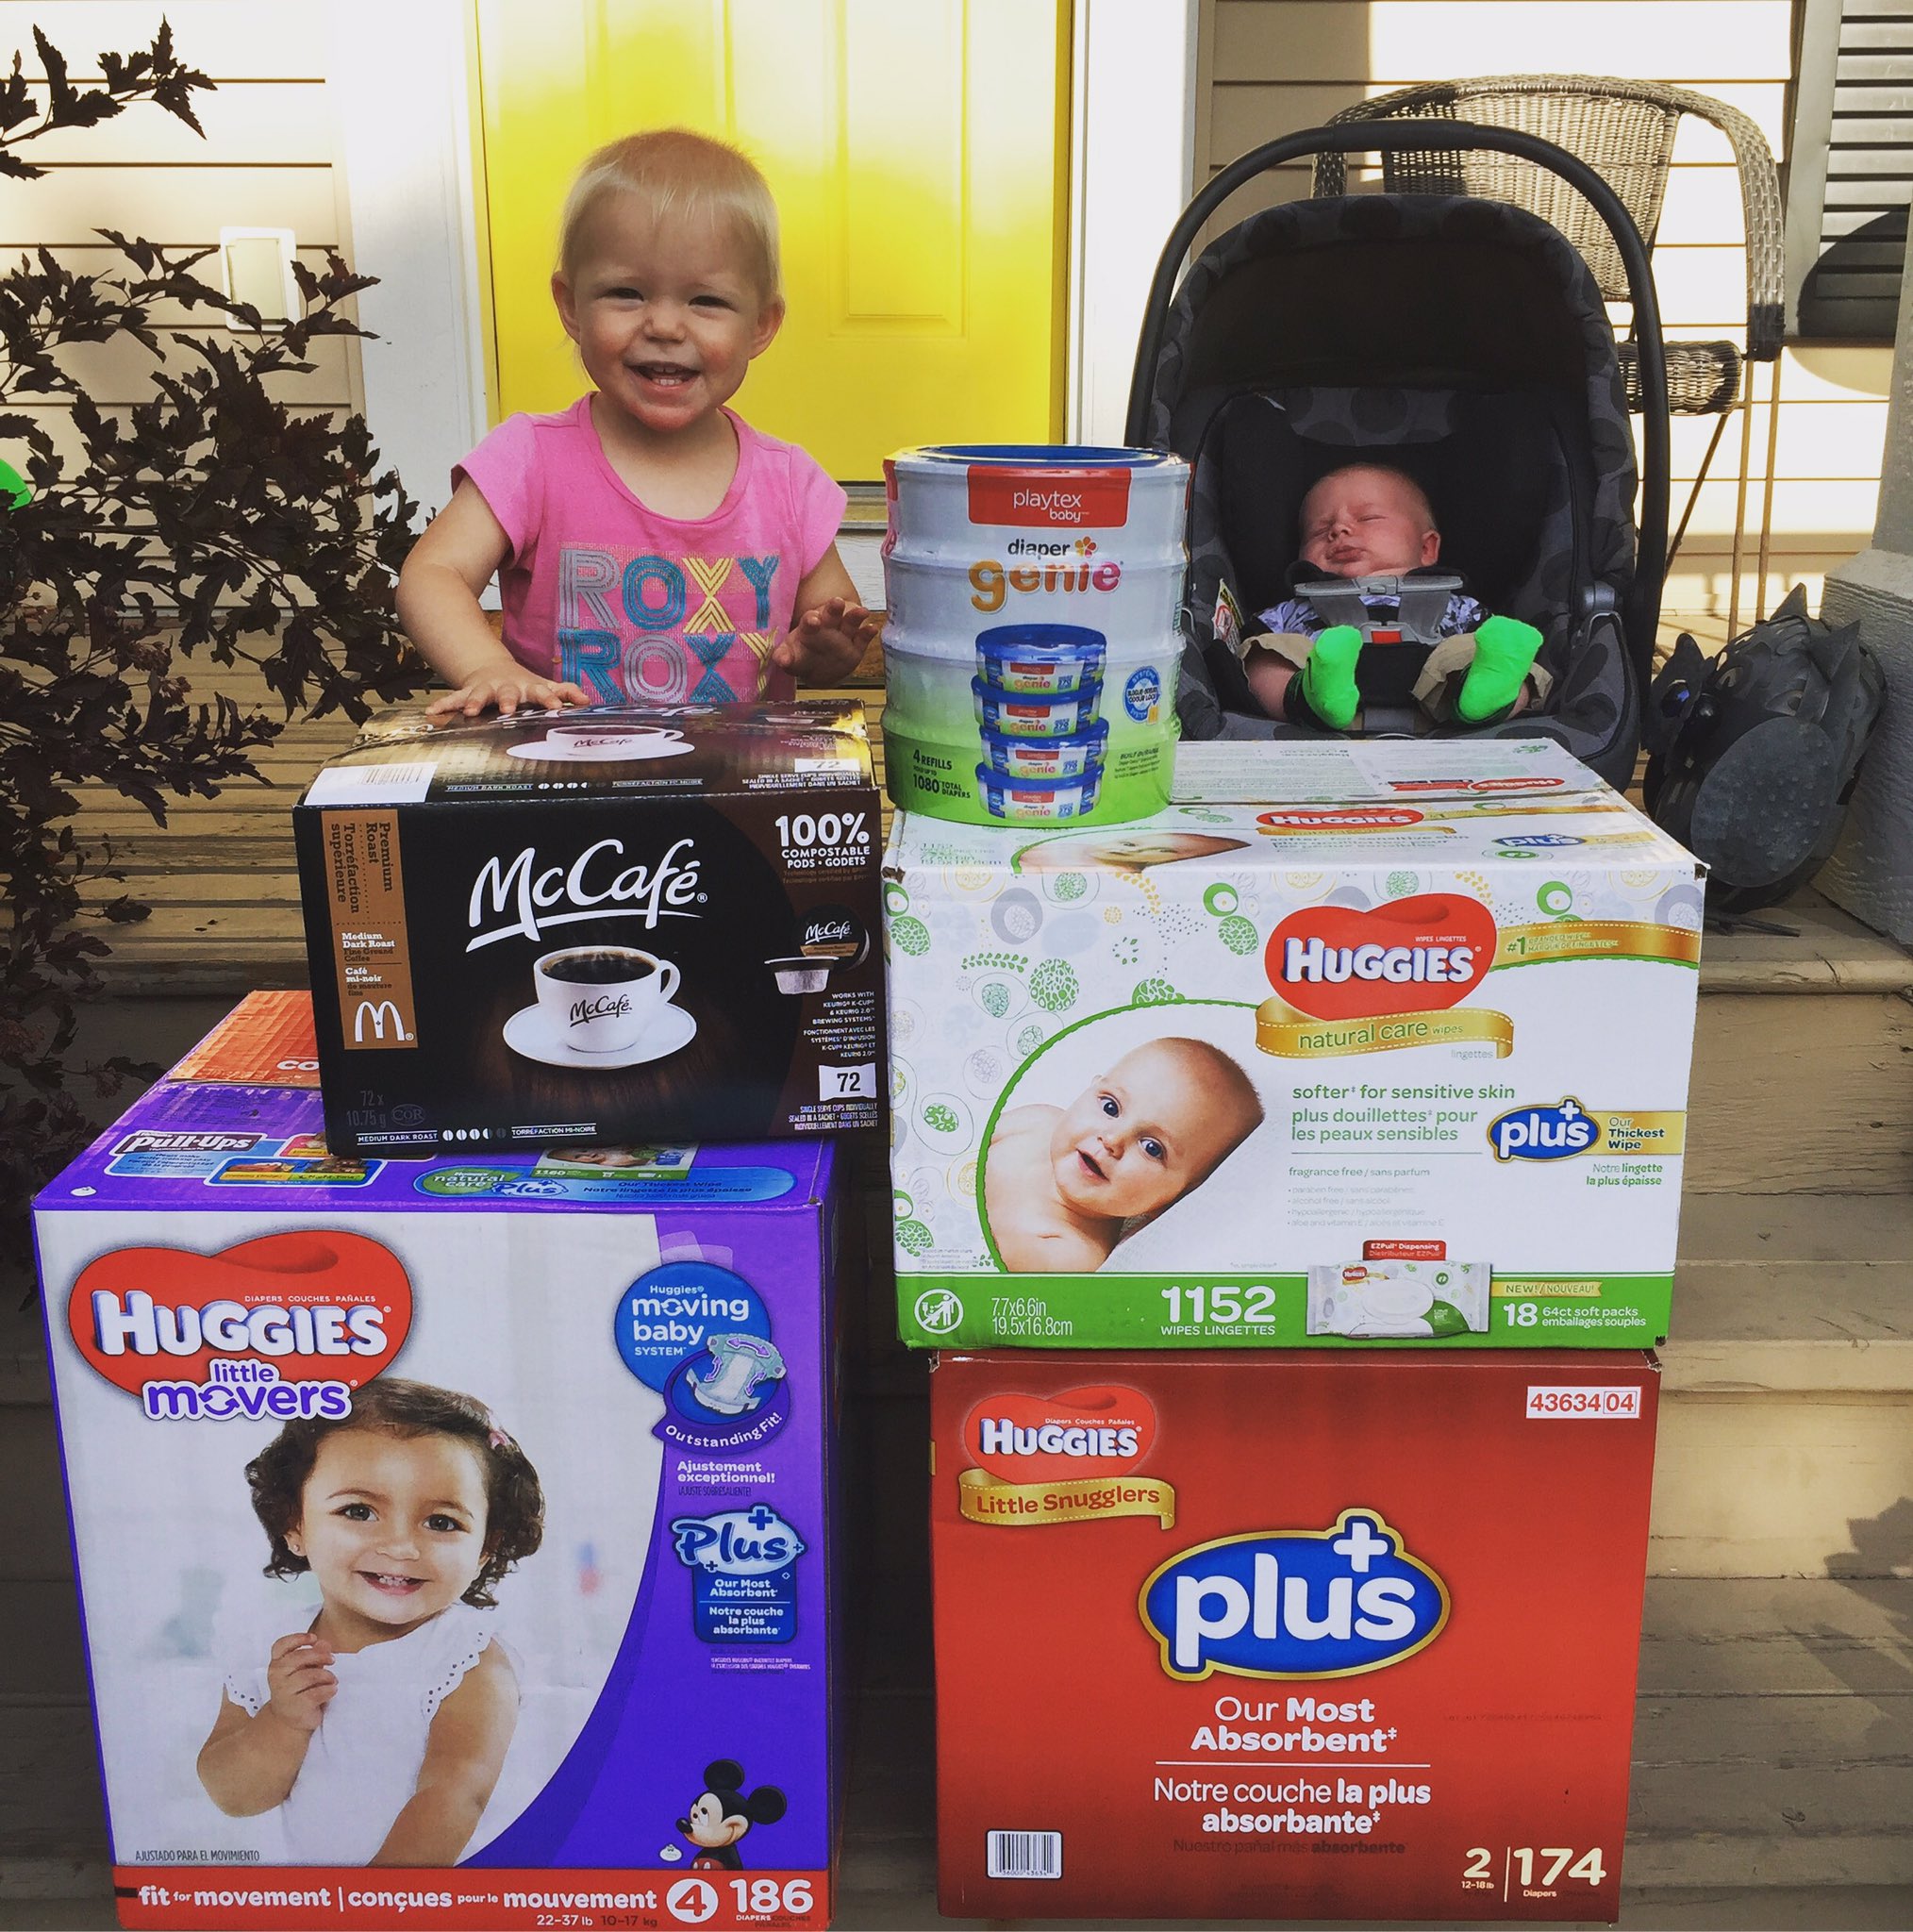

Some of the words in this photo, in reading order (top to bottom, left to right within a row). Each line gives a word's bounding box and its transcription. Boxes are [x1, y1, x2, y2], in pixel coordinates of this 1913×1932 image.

[1013, 489, 1082, 510] playtex
[1049, 508, 1081, 524] baby
[1007, 538, 1071, 560] diaper
[558, 548, 780, 634] ROXY
[968, 558, 1122, 614] genie
[913, 749, 920, 763] 4
[921, 755, 952, 770] REFILLS
[913, 774, 940, 793] 1080
[941, 781, 961, 791] TOTAL
[941, 789, 971, 798] DIAPERS
[775, 812, 870, 847] 100%
[366, 823, 378, 864] Roast
[781, 846, 871, 858] COMPOSTABLE
[329, 824, 347, 903] supérieure
[379, 823, 393, 891] Premium
[787, 858, 815, 869] PODS
[825, 857, 866, 867] GODETS
[343, 823, 360, 913] Torréfaction
[467, 839, 704, 946] McCafé
[341, 932, 383, 941] Medium
[805, 921, 851, 943] McCafé
[342, 940, 368, 948] Dark
[368, 940, 396, 948] Roast
[1506, 936, 1526, 955] #1
[1283, 937, 1474, 985] HUGGIES
[344, 967, 368, 975] Café
[345, 974, 383, 983] mi-noir
[570, 994, 632, 1026] McCafé
[803, 1027, 848, 1036] FONCTIONNENT
[1299, 1024, 1375, 1051] natural
[1379, 1020, 1428, 1041] care
[1432, 1024, 1464, 1037] wipes
[1451, 1049, 1493, 1061] lingettes
[837, 1072, 861, 1092] 72
[360, 1091, 374, 1107] 72
[377, 1094, 385, 1106] x
[1292, 1084, 1350, 1099] softer
[1359, 1084, 1388, 1099] for
[1391, 1084, 1473, 1099] sensitive
[1478, 1084, 1516, 1099] skin
[346, 1110, 377, 1127] 10.75
[859, 1119, 878, 1127] SACHET
[1291, 1108, 1329, 1125] plus
[1333, 1108, 1427, 1123] douillettes
[1436, 1110, 1478, 1125] pour
[1609, 1117, 1633, 1127] Our
[358, 1135, 388, 1143] MEDIUM
[1291, 1126, 1316, 1141] les
[1320, 1130, 1373, 1144] peaux
[1376, 1126, 1459, 1141] sensibles
[1499, 1112, 1589, 1158] plus
[1609, 1128, 1665, 1138] Thickest
[128, 1134, 251, 1152] Pull-Ups
[1608, 1140, 1641, 1152] Wipe
[1289, 1167, 1339, 1178] fragrance
[1341, 1167, 1364, 1176] free
[1394, 1167, 1431, 1178] parfum
[1592, 1163, 1621, 1174] Notre
[1622, 1162, 1663, 1175] lingette
[1586, 1175, 1596, 1185] la
[1597, 1175, 1621, 1188] plus
[1622, 1175, 1662, 1188] épaisse
[1398, 1242, 1440, 1252] Dispensing
[335, 1293, 376, 1303] PAÑALES
[649, 1285, 698, 1295] Huggies
[632, 1293, 750, 1322] moving
[991, 1297, 1047, 1318] 7.7x6.6in
[1161, 1285, 1276, 1324] 1152
[1542, 1307, 1572, 1317] 64ct
[1574, 1306, 1599, 1317] soft
[1602, 1306, 1639, 1319] packs
[91, 1290, 389, 1357] HUGGIES
[1503, 1303, 1539, 1327] 18
[1542, 1317, 1604, 1329] emballages
[1605, 1317, 1646, 1328] souples
[633, 1320, 705, 1346] baby
[992, 1317, 1073, 1337] 19.5x16.8cm
[1161, 1325, 1201, 1336] WIPES
[1205, 1324, 1276, 1336] LINGETTES
[634, 1346, 684, 1357] SYSTEM
[210, 1360, 276, 1385] little
[146, 1383, 347, 1417] movers
[1530, 1392, 1602, 1412] 43634
[1605, 1392, 1635, 1412] 04
[665, 1424, 763, 1448] Outstanding
[758, 1411, 783, 1434] Fit!
[980, 1418, 1139, 1457] HUGGIES
[677, 1460, 762, 1474] Ajustement
[677, 1472, 775, 1485] exceptionnel!
[976, 1495, 1039, 1514] Little
[1043, 1486, 1160, 1511] Snugglers
[675, 1521, 788, 1563] Plus
[709, 1588, 776, 1597] Absorbent
[714, 1579, 739, 1589] Our
[740, 1579, 772, 1589] Most
[709, 1607, 742, 1616] Notre
[743, 1607, 784, 1616] couche
[1175, 1552, 1417, 1669] plus
[728, 1616, 740, 1625] la
[740, 1616, 766, 1627] plus
[713, 1626, 779, 1635] absorbante
[1214, 1696, 1279, 1722] Our
[1286, 1697, 1375, 1723] Most
[1154, 1777, 1229, 1803] Notre
[1233, 1777, 1332, 1804] couche
[1337, 1777, 1363, 1804] la
[1368, 1778, 1432, 1810] plus
[1173, 1840, 1232, 1852] Nuestro
[135, 1849, 175, 1861] AJUSTADO
[176, 1849, 199, 1861] PARA
[200, 1849, 209, 1861] EL
[210, 1849, 260, 1861] MOVIMIENTO
[1463, 1847, 1492, 1878] 2
[1513, 1847, 1607, 1886] 174
[1461, 1880, 1486, 1890] 12-18
[1486, 1880, 1495, 1890] lb
[141, 1885, 171, 1907] fit
[173, 1891, 191, 1902] for
[193, 1888, 332, 1907] movement
[347, 1889, 454, 1913] conçues
[457, 1894, 485, 1906] pour
[487, 1891, 499, 1904] le
[503, 1890, 657, 1909] mouvement
[674, 1883, 708, 1918] 4
[729, 1878, 814, 1914] 186
[1522, 1890, 1557, 1899] Diapers
[537, 1914, 580, 1927] 22-37
[581, 1914, 593, 1926] lb
[600, 1915, 639, 1927] 10-17
[642, 1916, 658, 1929] kg
